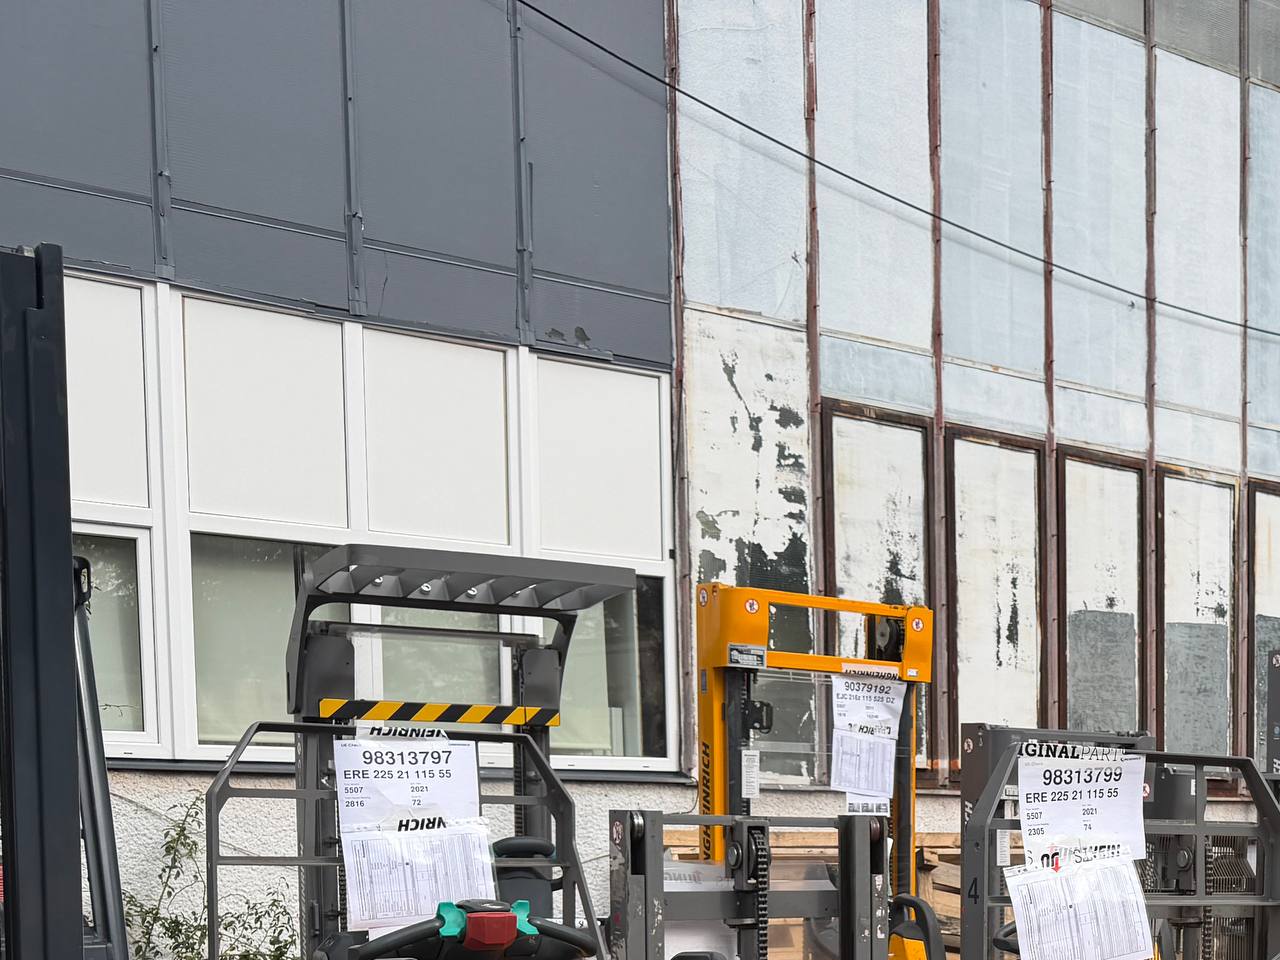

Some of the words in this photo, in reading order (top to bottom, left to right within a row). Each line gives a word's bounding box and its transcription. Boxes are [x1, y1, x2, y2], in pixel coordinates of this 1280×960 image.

[844, 681, 892, 694] 90379192
[362, 750, 452, 765] 98313797
[343, 769, 370, 779] ERE
[373, 770, 394, 779] 225
[397, 770, 410, 779] 21
[415, 769, 435, 779] 115
[438, 769, 452, 778] 55
[1042, 766, 1123, 786] 98313799
[344, 786, 363, 794] 5507
[1025, 791, 1048, 803] ERE
[1050, 790, 1069, 802] 225
[1072, 789, 1083, 800] 21
[1087, 788, 1104, 799] 115
[1107, 787, 1119, 798] 55
[1026, 811, 1043, 820] 5507
[1082, 808, 1098, 816] 2021
[1027, 827, 1045, 836] 2305
[1083, 823, 1092, 831] 74
[968, 878, 980, 904] 4
